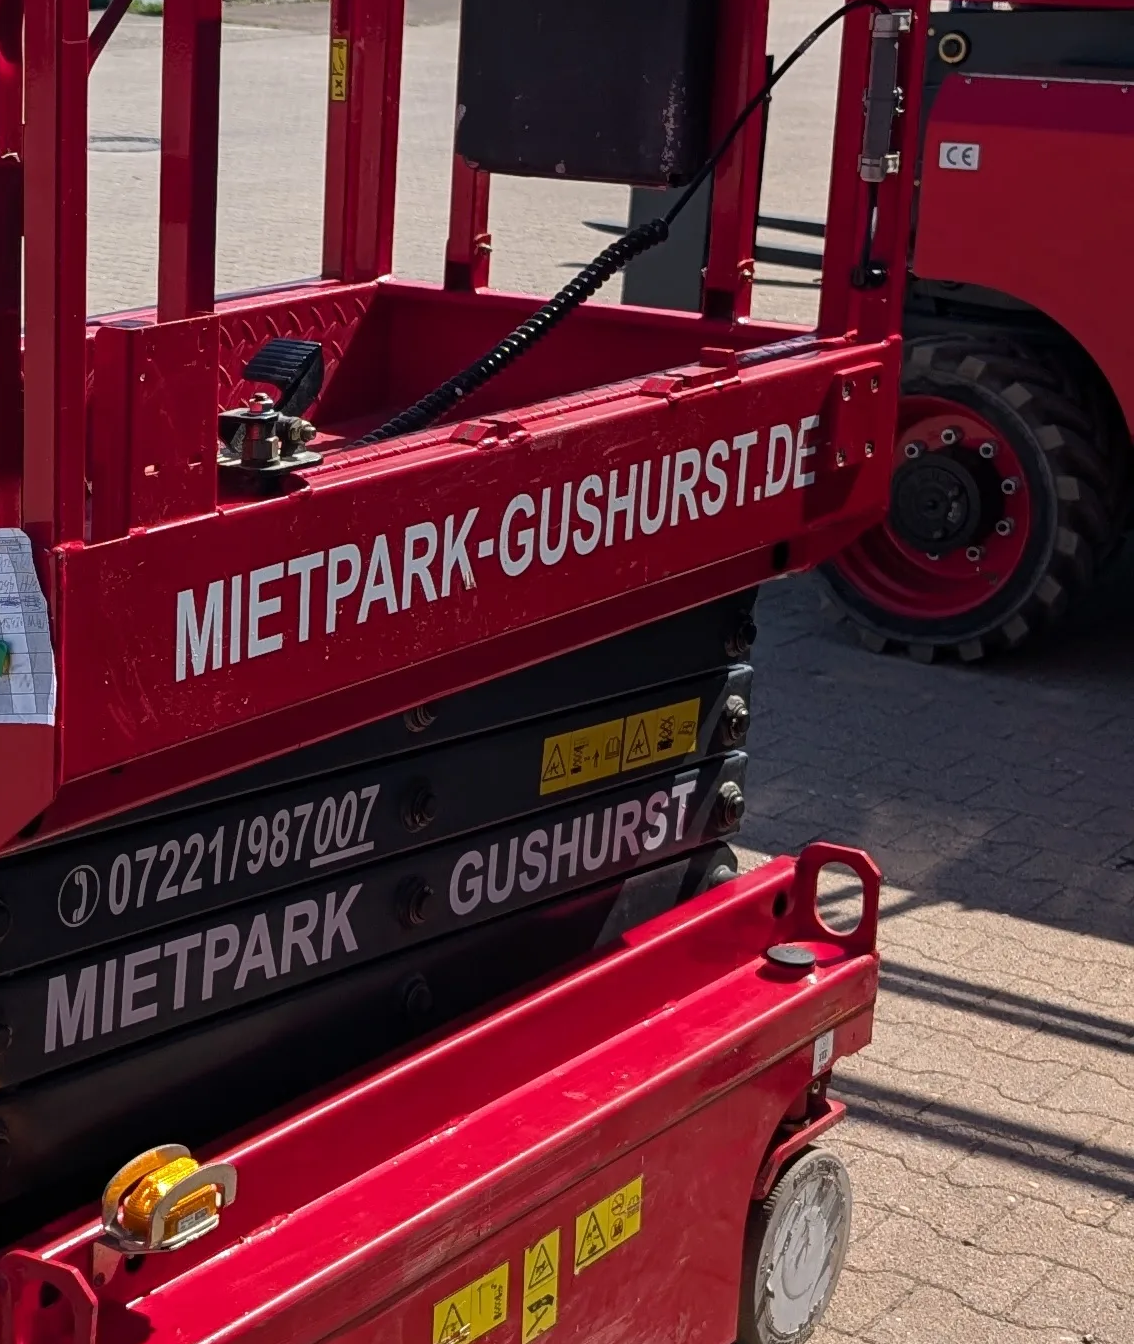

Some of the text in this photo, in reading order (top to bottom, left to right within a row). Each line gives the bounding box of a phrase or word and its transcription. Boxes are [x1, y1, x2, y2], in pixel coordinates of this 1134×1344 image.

[946, 146, 973, 166] CE
[175, 414, 820, 683] MIETPARK-GUSHURST.DE
[108, 784, 381, 916] 07221/987007
[449, 780, 697, 918] GUSHURST
[44, 883, 363, 1054] MIETPARK
